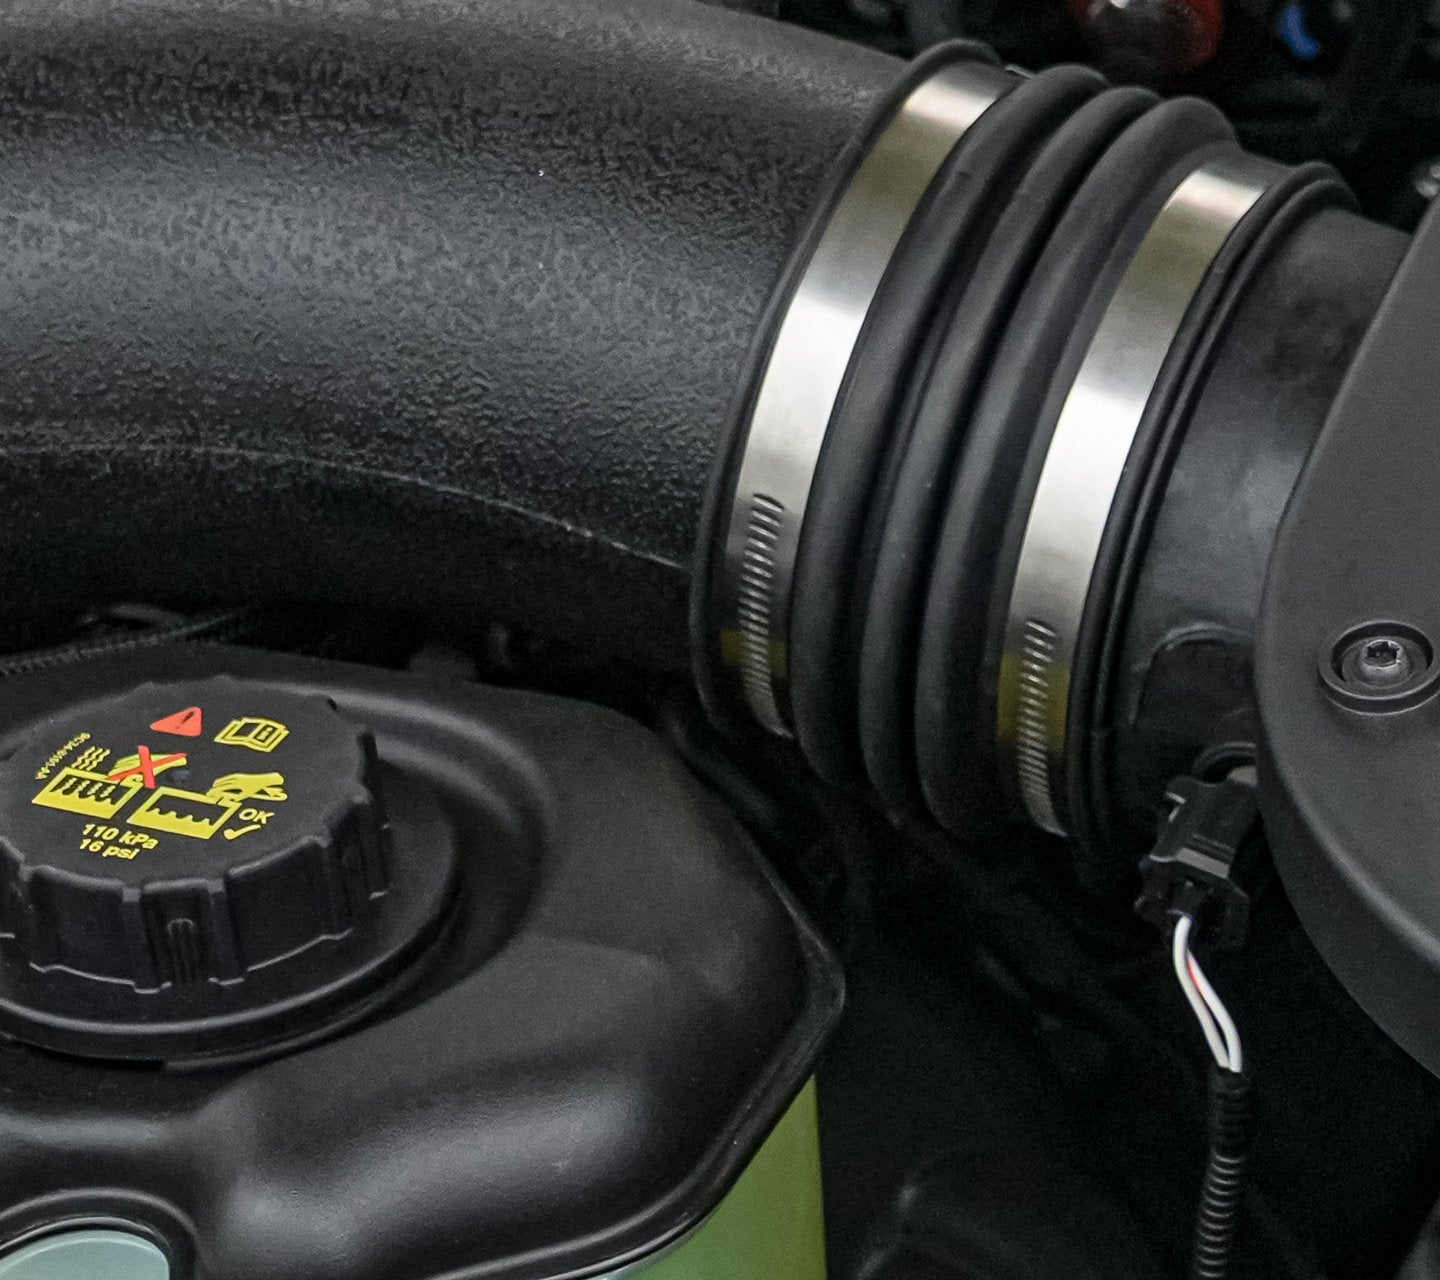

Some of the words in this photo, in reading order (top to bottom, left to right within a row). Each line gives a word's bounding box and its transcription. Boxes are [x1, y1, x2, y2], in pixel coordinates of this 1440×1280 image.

[237, 807, 276, 825] OK
[81, 823, 120, 840] 110
[118, 830, 160, 850] kPa
[79, 837, 105, 853] 16
[101, 844, 140, 860] psi
